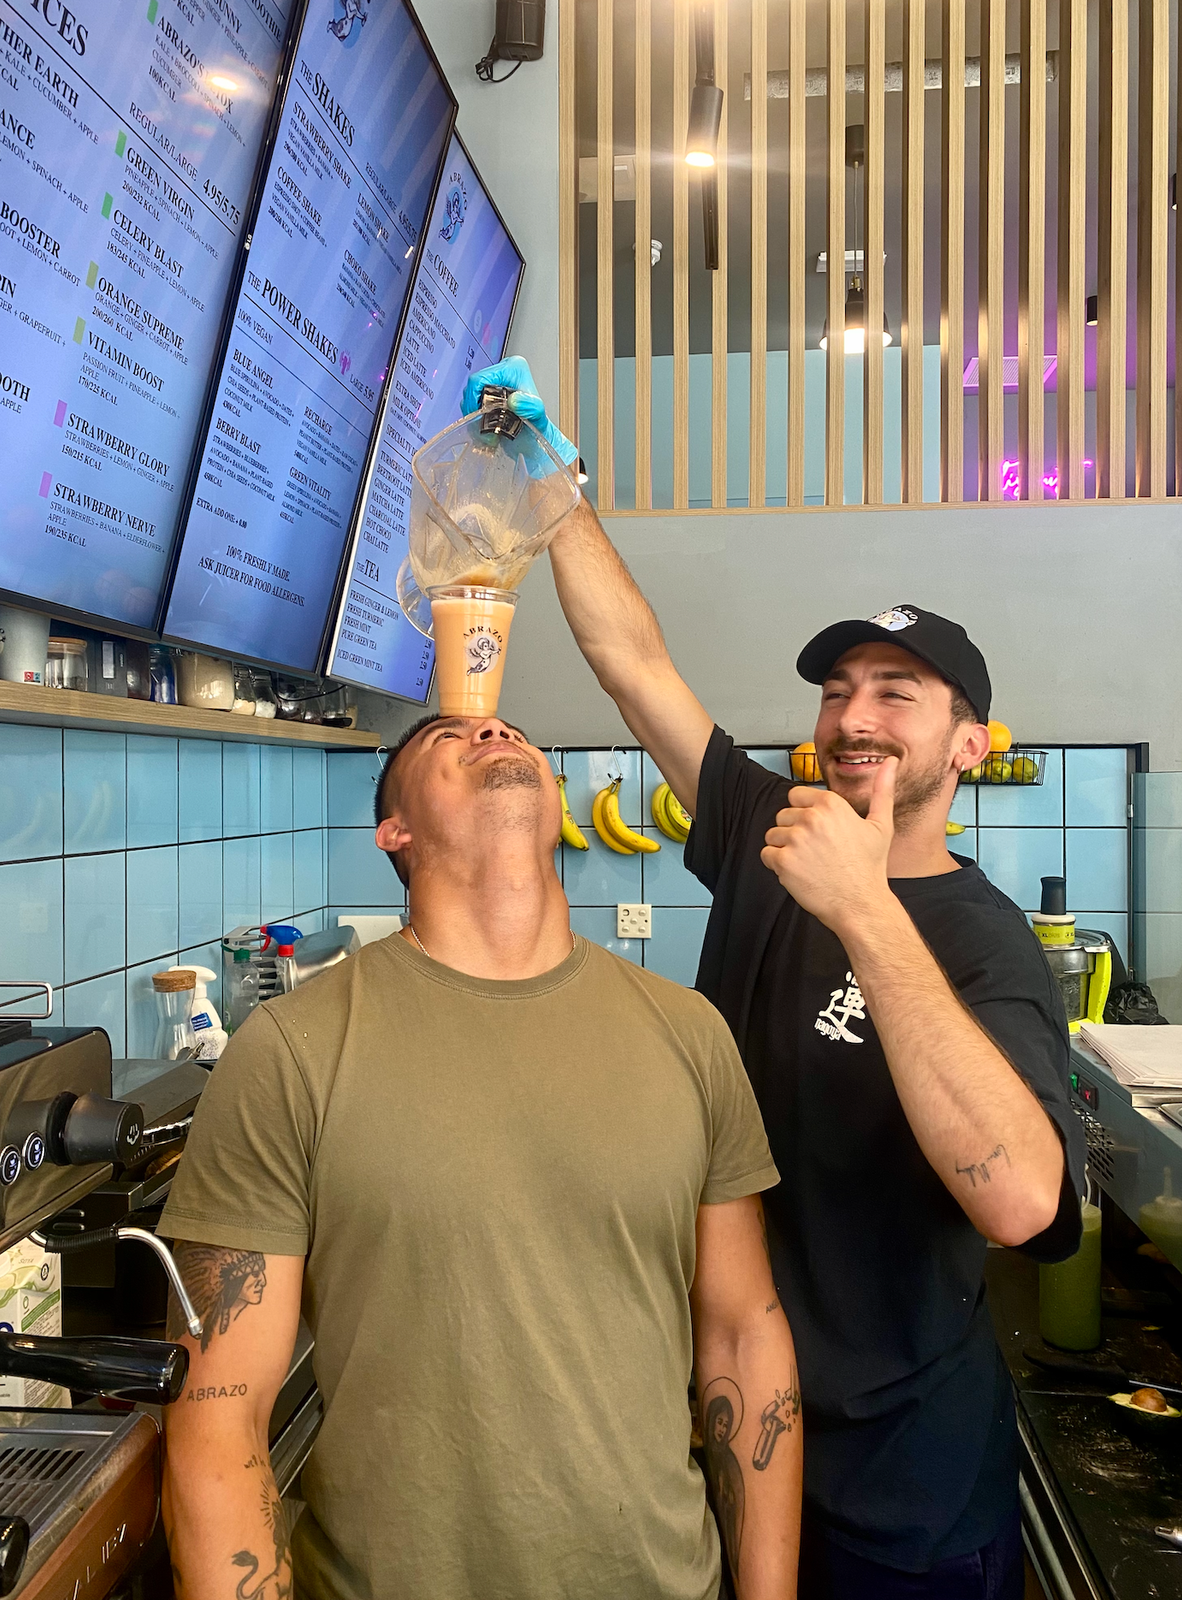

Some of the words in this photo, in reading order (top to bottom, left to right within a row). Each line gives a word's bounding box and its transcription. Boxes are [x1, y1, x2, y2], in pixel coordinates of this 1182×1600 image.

[215, 0, 243, 33] UNNY
[4, 51, 27, 76] KALE
[32, 77, 73, 121] CUCUMBER
[77, 121, 99, 145] APPLE
[34, 54, 79, 109] EARTH
[301, 59, 313, 85] THE
[312, 72, 355, 147] SHAKES
[129, 101, 198, 181] REGULAR/LARGE
[202, 178, 241, 225] 4.95/5.75
[293, 101, 334, 162] STRAWBERRY
[332, 157, 352, 189] SHAKE
[31, 160, 63, 192] SPINACH
[67, 192, 89, 214] APPLE
[127, 147, 162, 188] GREEN
[163, 181, 195, 221] VIRGIN
[277, 166, 303, 203] COFFEE
[301, 195, 322, 227] SHAKE
[0, 200, 61, 259] BOOSTER
[143, 198, 160, 222] KCAL
[22, 238, 48, 263] LEMON
[53, 261, 81, 287] CARROT
[110, 227, 134, 253] CELERY
[137, 250, 165, 280] PINEAPPLE
[113, 209, 155, 252] CELERY
[153, 243, 185, 279] BLAST
[127, 259, 146, 279] KCAL
[433, 254, 459, 297] COFFEE
[94, 291, 119, 316] ORANGE
[98, 277, 142, 319] ORANGE
[141, 309, 185, 351] SUPREME
[246, 270, 262, 292] THE
[261, 277, 302, 331] POWER
[300, 317, 339, 365] SHAKES
[19, 312, 62, 346] GRAPEFRUIT
[115, 322, 134, 342] KCAL
[237, 308, 252, 328] 100%
[252, 320, 274, 345] VEGAN
[405, 332, 420, 354] LATTE
[80, 364, 100, 382] APPLE
[82, 351, 108, 374] PASSION
[107, 369, 125, 386] FRUIT
[128, 381, 156, 406] PINEAPPLE
[88, 330, 133, 372] VITAMIN
[132, 361, 165, 393] BOOST
[233, 348, 253, 372] BLUE
[251, 364, 274, 389] ANGEL
[99, 389, 118, 407] KCAL
[64, 429, 110, 460] STRAWBERRIES
[112, 454, 133, 471] LEMON
[67, 412, 139, 461] STRAWBERRY
[138, 450, 170, 477] GLORY
[215, 417, 241, 442] BERRY
[239, 432, 262, 456] BLAST
[83, 456, 103, 472] KCAL
[47, 512, 68, 527] APPLE
[50, 500, 95, 526] STRAWBERRIES
[99, 521, 122, 538] BANANA
[53, 482, 126, 524] STRAWBERRY
[124, 513, 157, 538] NERVE
[196, 497, 214, 513] EXTRA
[213, 507, 225, 518] ADD
[67, 532, 87, 548] KCAL
[226, 544, 244, 562] 100%
[242, 552, 273, 575] FRESHLY
[198, 556, 215, 572] ASK
[213, 561, 241, 582] JUICER
[239, 571, 256, 589] FOR
[254, 577, 273, 595] FOOD
[364, 559, 380, 582] TEA
[341, 628, 354, 641] PURE
[462, 625, 503, 644] ABRAZO
[186, 1383, 248, 1402] ABRAZO
